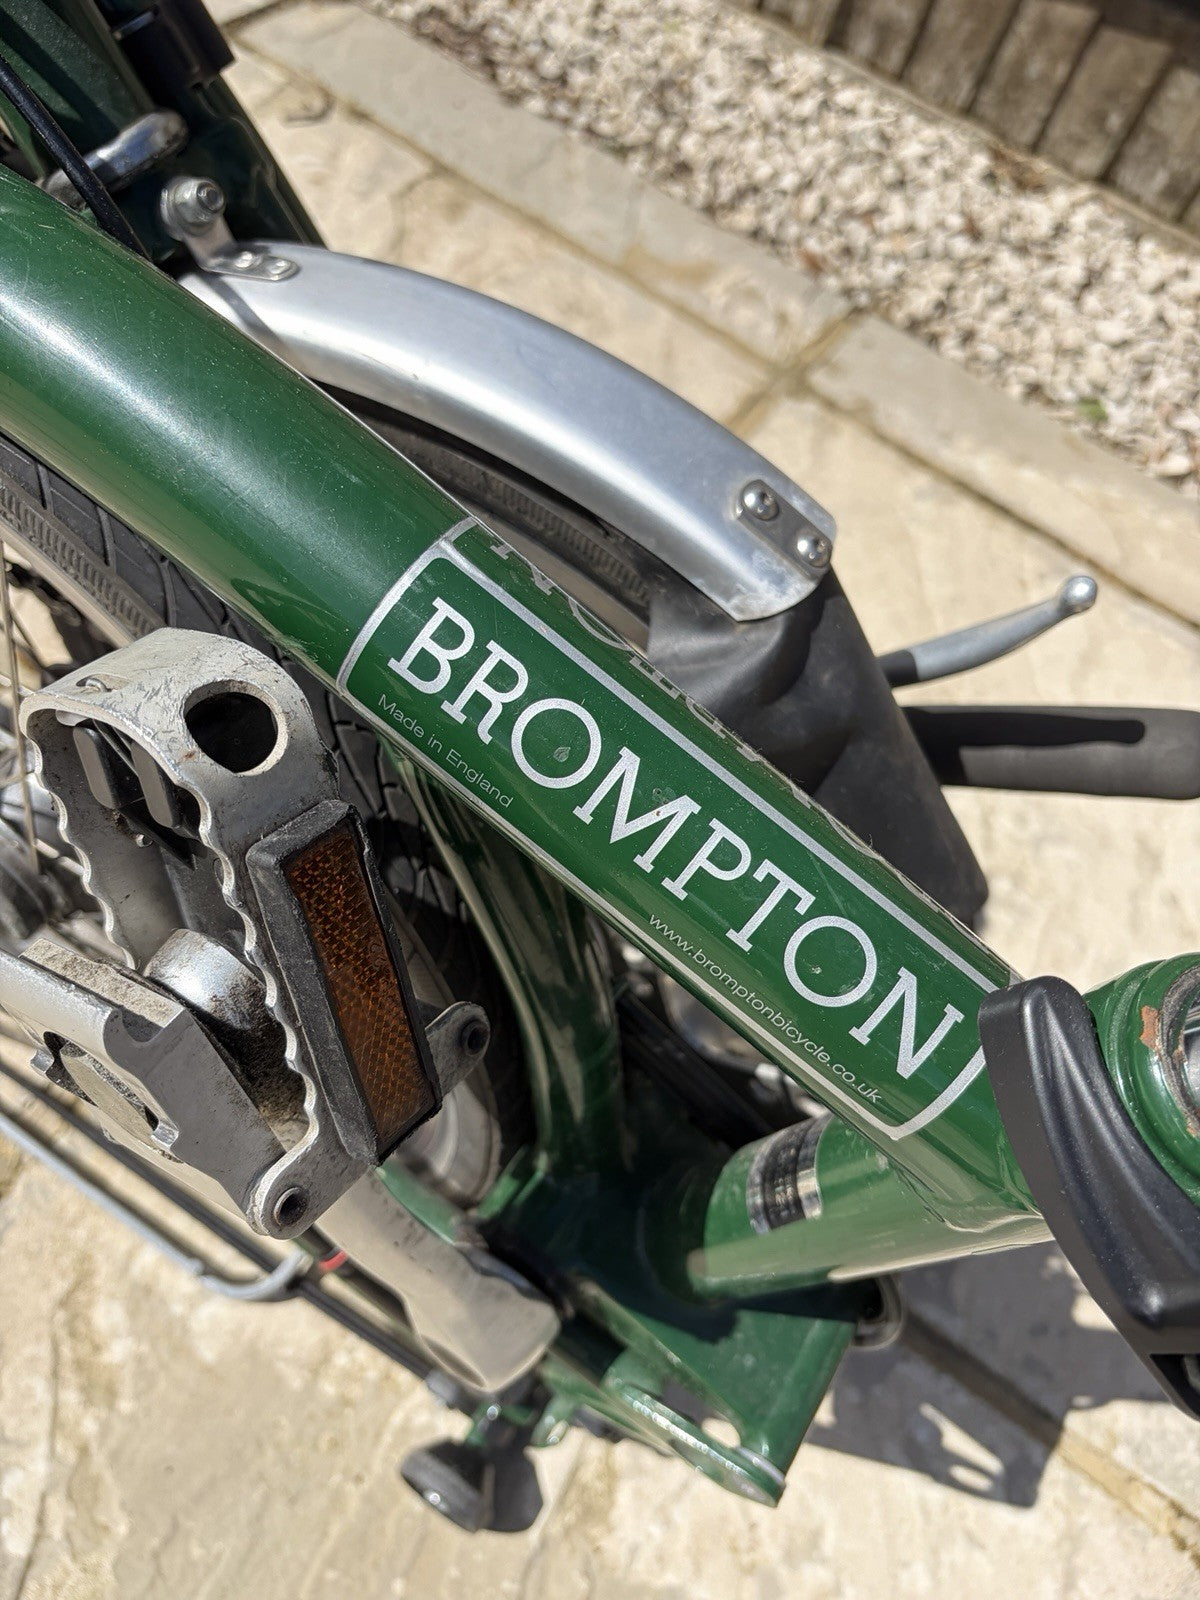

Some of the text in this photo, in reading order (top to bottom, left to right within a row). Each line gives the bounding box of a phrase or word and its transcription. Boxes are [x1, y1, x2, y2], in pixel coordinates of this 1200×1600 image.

[377, 693, 515, 809] Made in England
[387, 596, 965, 1080] BROMPTON
[649, 913, 882, 1104] www.bromptonbicycle.co.uk
